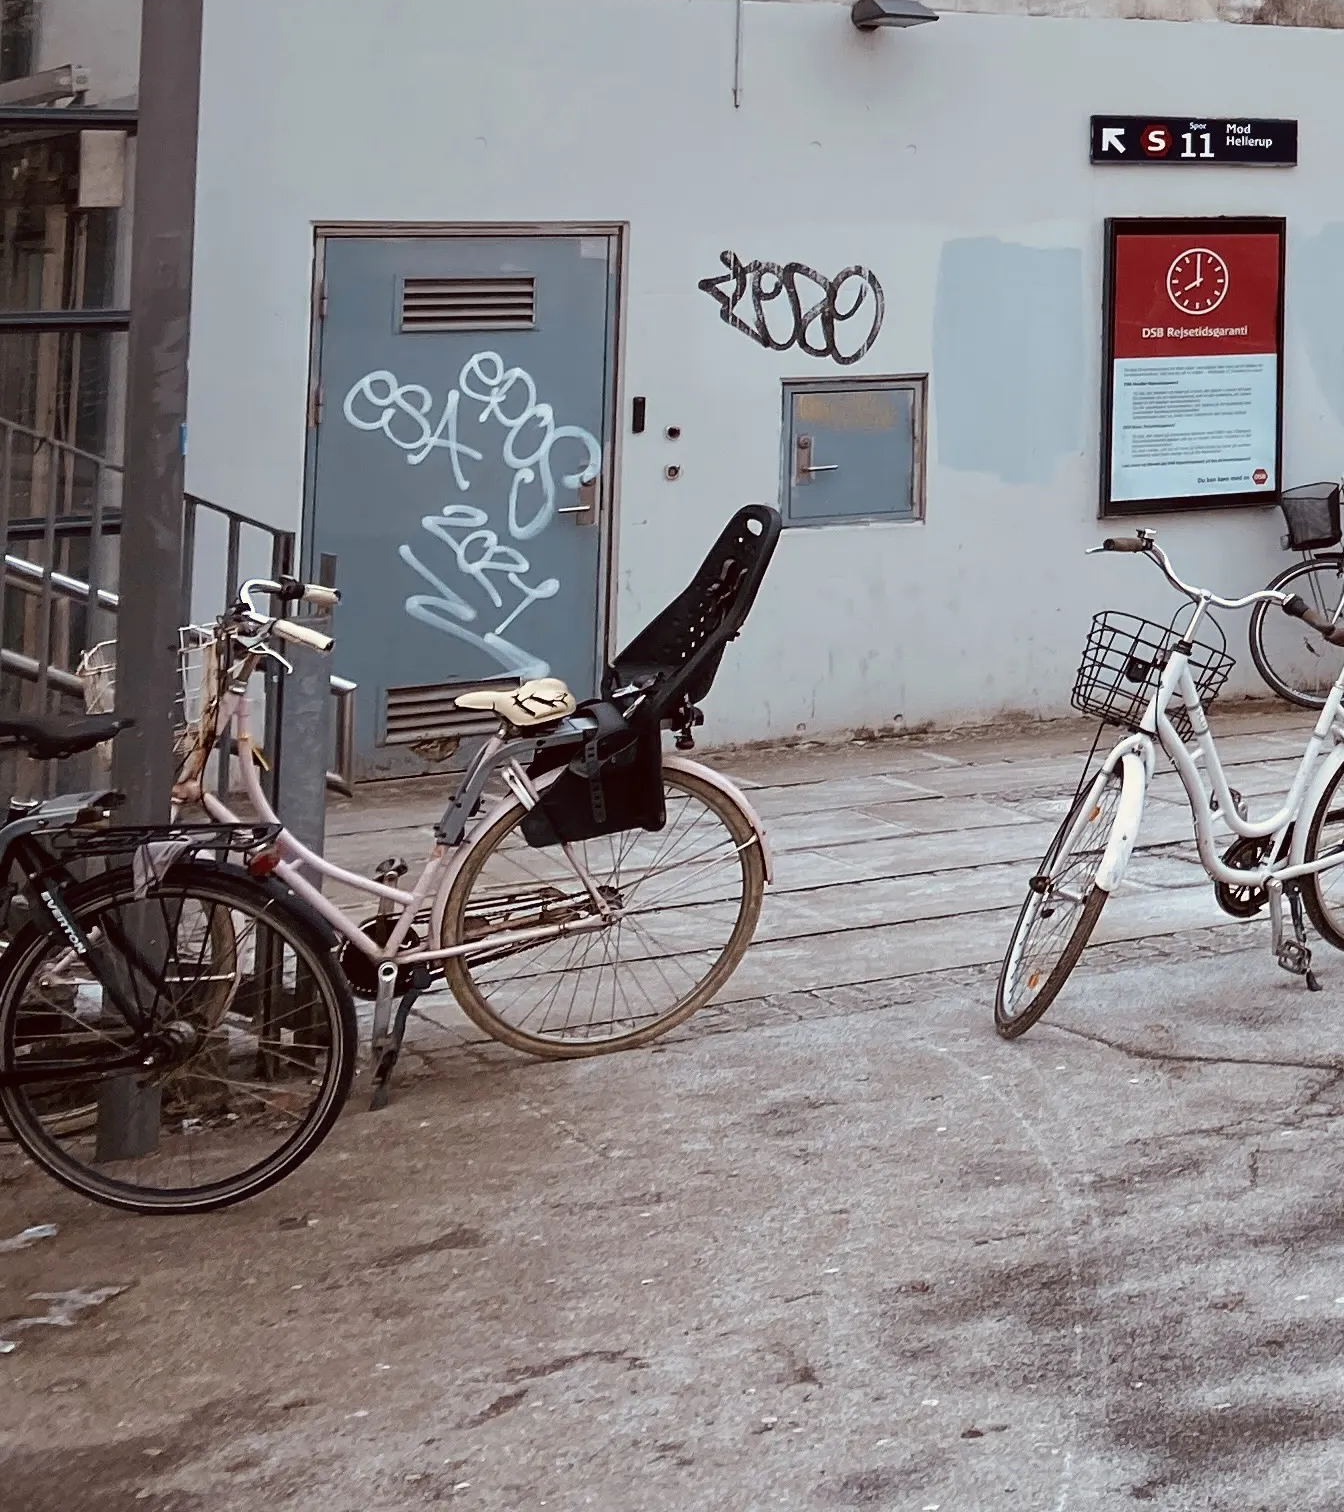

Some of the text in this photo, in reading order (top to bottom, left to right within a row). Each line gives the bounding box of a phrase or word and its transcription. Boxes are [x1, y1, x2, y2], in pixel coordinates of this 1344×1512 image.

[1189, 121, 1207, 130] Spor
[1226, 123, 1251, 134] Mod
[1147, 130, 1166, 152] S
[1180, 132, 1215, 158] 11
[1226, 136, 1273, 149] Hellerup
[1141, 325, 1248, 339] DSB Rejsetidsgaranti
[41, 890, 87, 955] EVERTON
